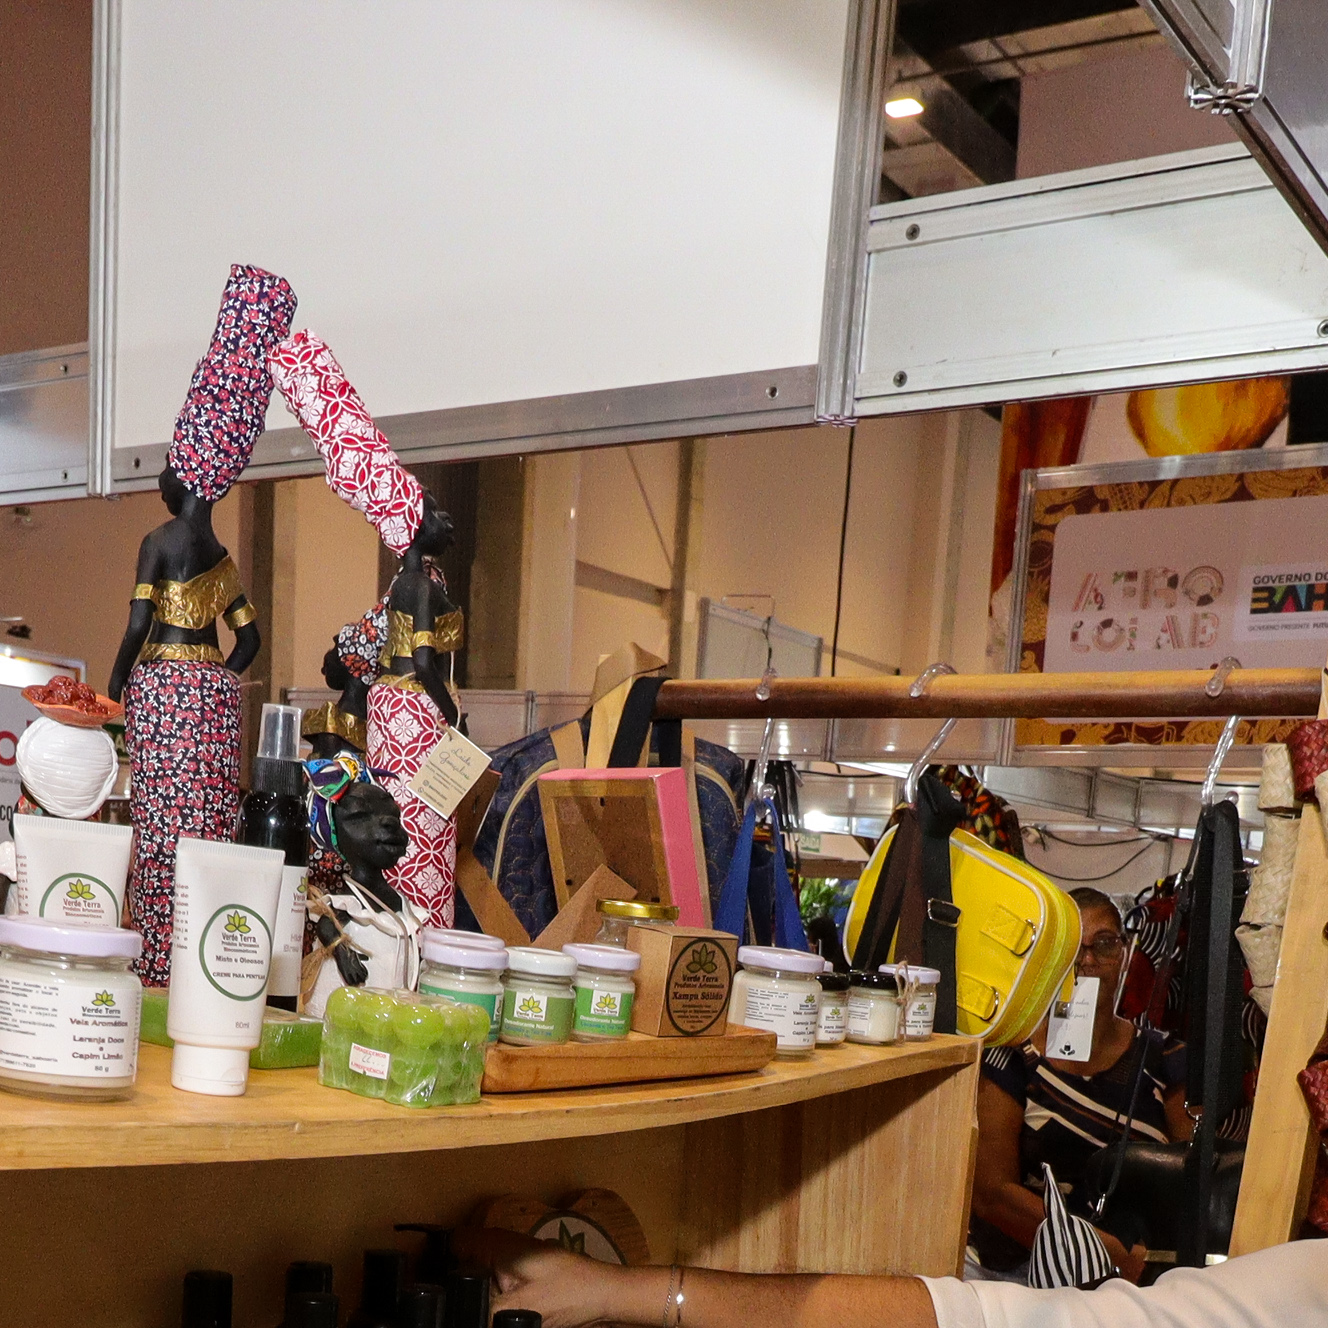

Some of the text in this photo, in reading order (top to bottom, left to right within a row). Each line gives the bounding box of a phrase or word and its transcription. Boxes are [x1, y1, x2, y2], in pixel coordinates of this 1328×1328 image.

[1253, 572, 1313, 585] GOVERNO
[63, 898, 101, 908] Verde Terra
[222, 933, 256, 943] Verde Terra
[682, 974, 700, 982] Verde
[672, 991, 723, 1001] Xampu Sólido
[82, 1006, 102, 1014] Verde
[73, 1035, 105, 1044] Laranja
[72, 1052, 100, 1061] Capim
